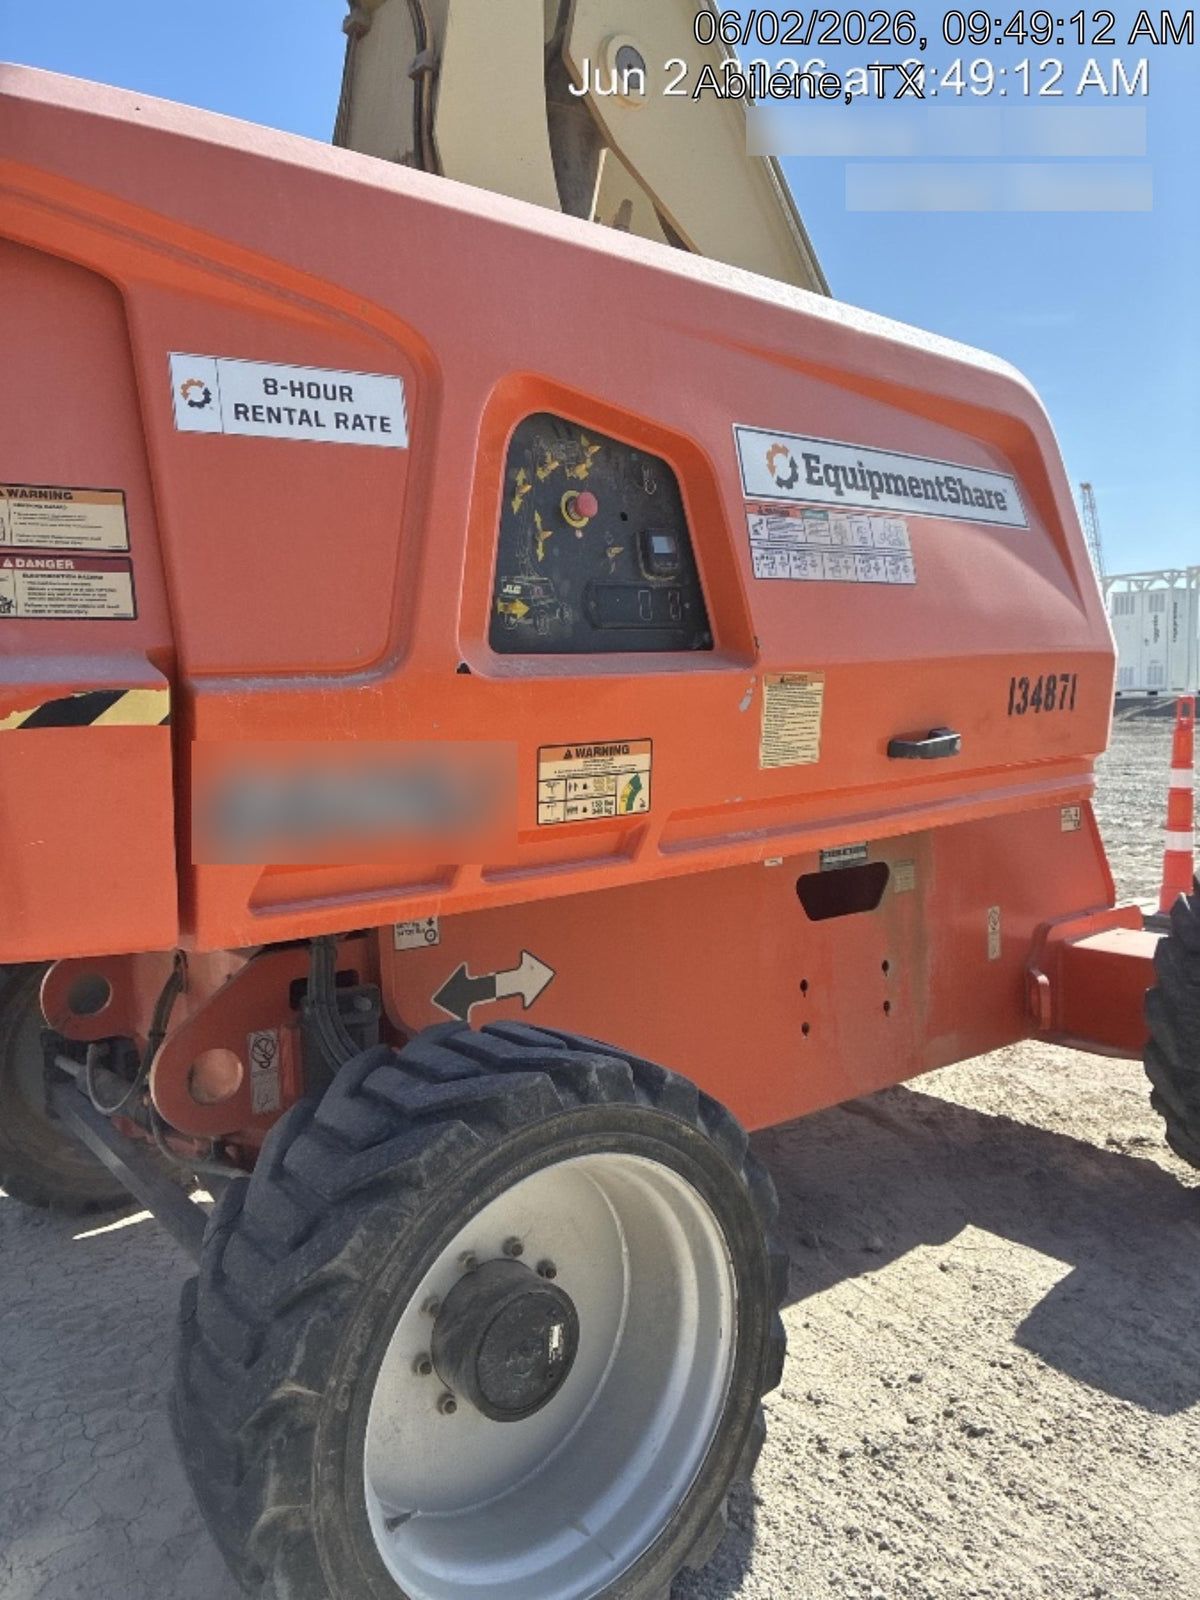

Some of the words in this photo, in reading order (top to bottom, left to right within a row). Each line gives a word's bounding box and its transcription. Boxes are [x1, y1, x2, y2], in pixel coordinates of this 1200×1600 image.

[262, 377, 354, 403] 8-HOUR
[233, 403, 327, 428] RENTAL
[334, 412, 392, 433] RATE
[6, 488, 74, 501] WARNING
[801, 452, 1008, 512] EquipmentShare
[15, 558, 76, 570] DANGER
[1007, 673, 1078, 716] 134871
[575, 744, 630, 758] WARNING
